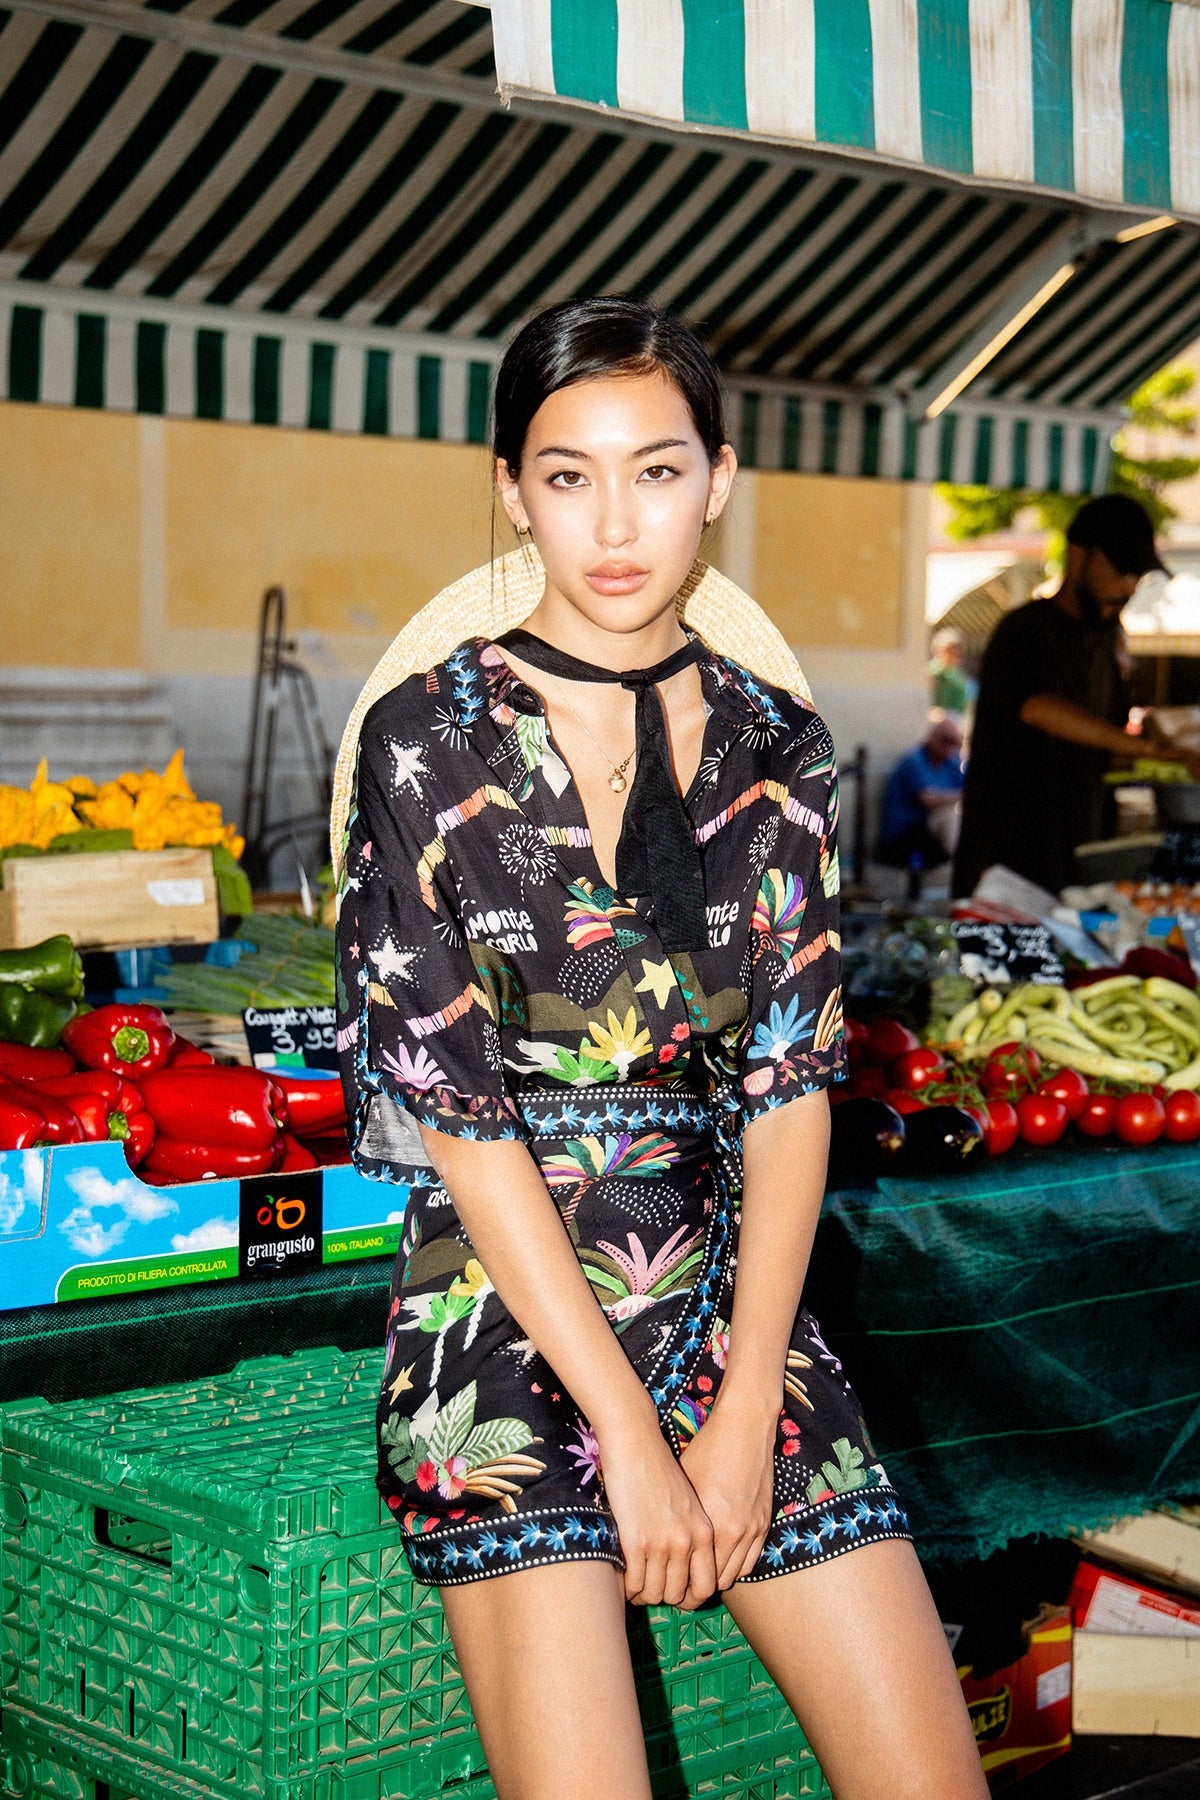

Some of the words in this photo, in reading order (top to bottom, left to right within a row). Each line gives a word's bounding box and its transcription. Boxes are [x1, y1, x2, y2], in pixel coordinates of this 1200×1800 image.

[705, 899, 740, 926] nte
[247, 1234, 315, 1267] grangusto
[327, 1242, 348, 1253] 100%
[349, 1236, 383, 1250] ITALIANO
[78, 1273, 126, 1289] PRODOTTO
[127, 1272, 136, 1283] DI
[138, 1269, 167, 1281] FILIERA
[169, 1260, 227, 1278] CONTROLLATA
